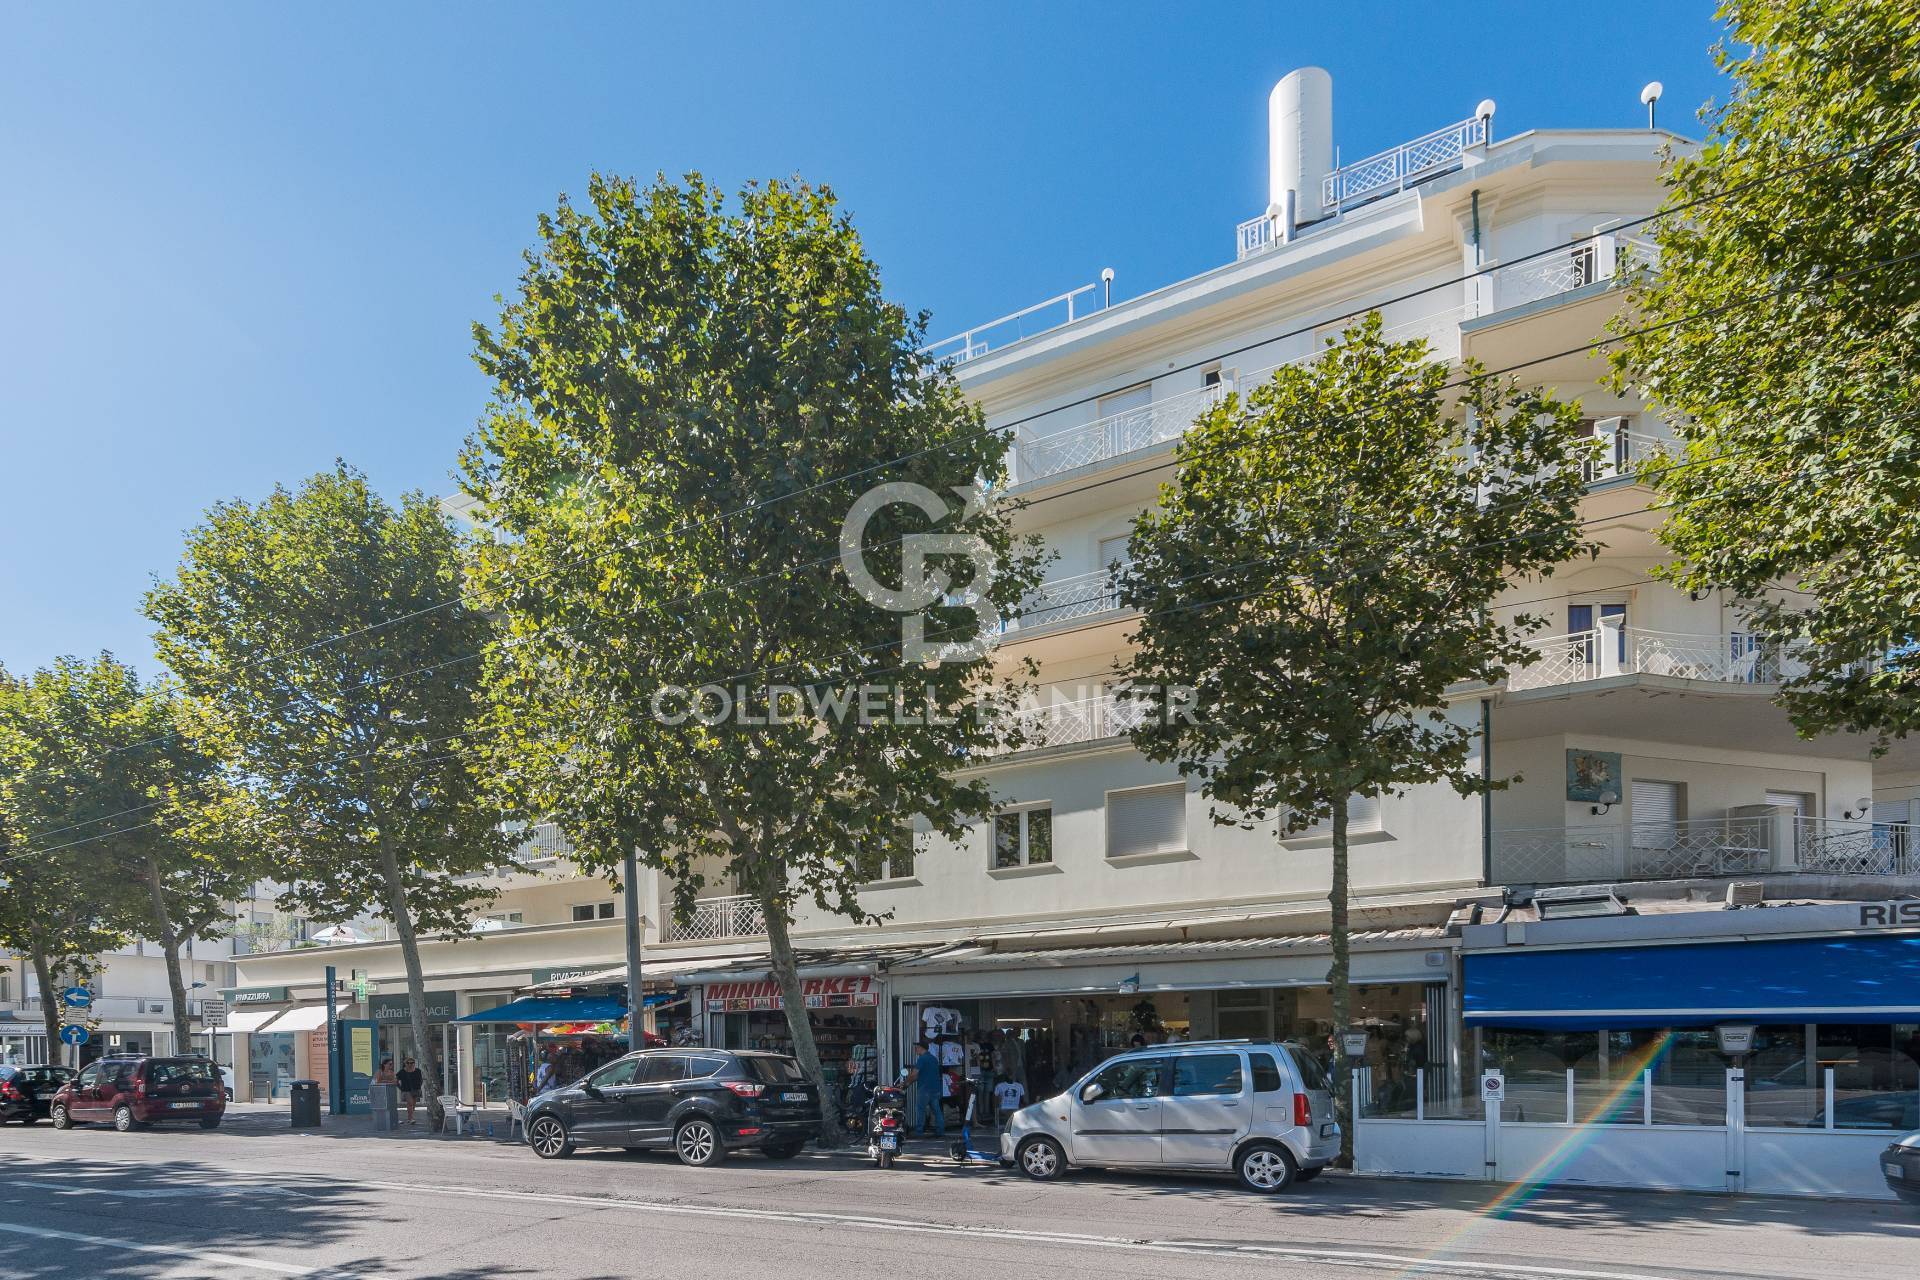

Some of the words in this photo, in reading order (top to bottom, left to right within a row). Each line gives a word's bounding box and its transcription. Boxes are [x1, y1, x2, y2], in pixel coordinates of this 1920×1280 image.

[1860, 903, 1920, 926] RIS
[706, 975, 870, 999] MINIMRKET
[375, 1003, 402, 1019] alma
